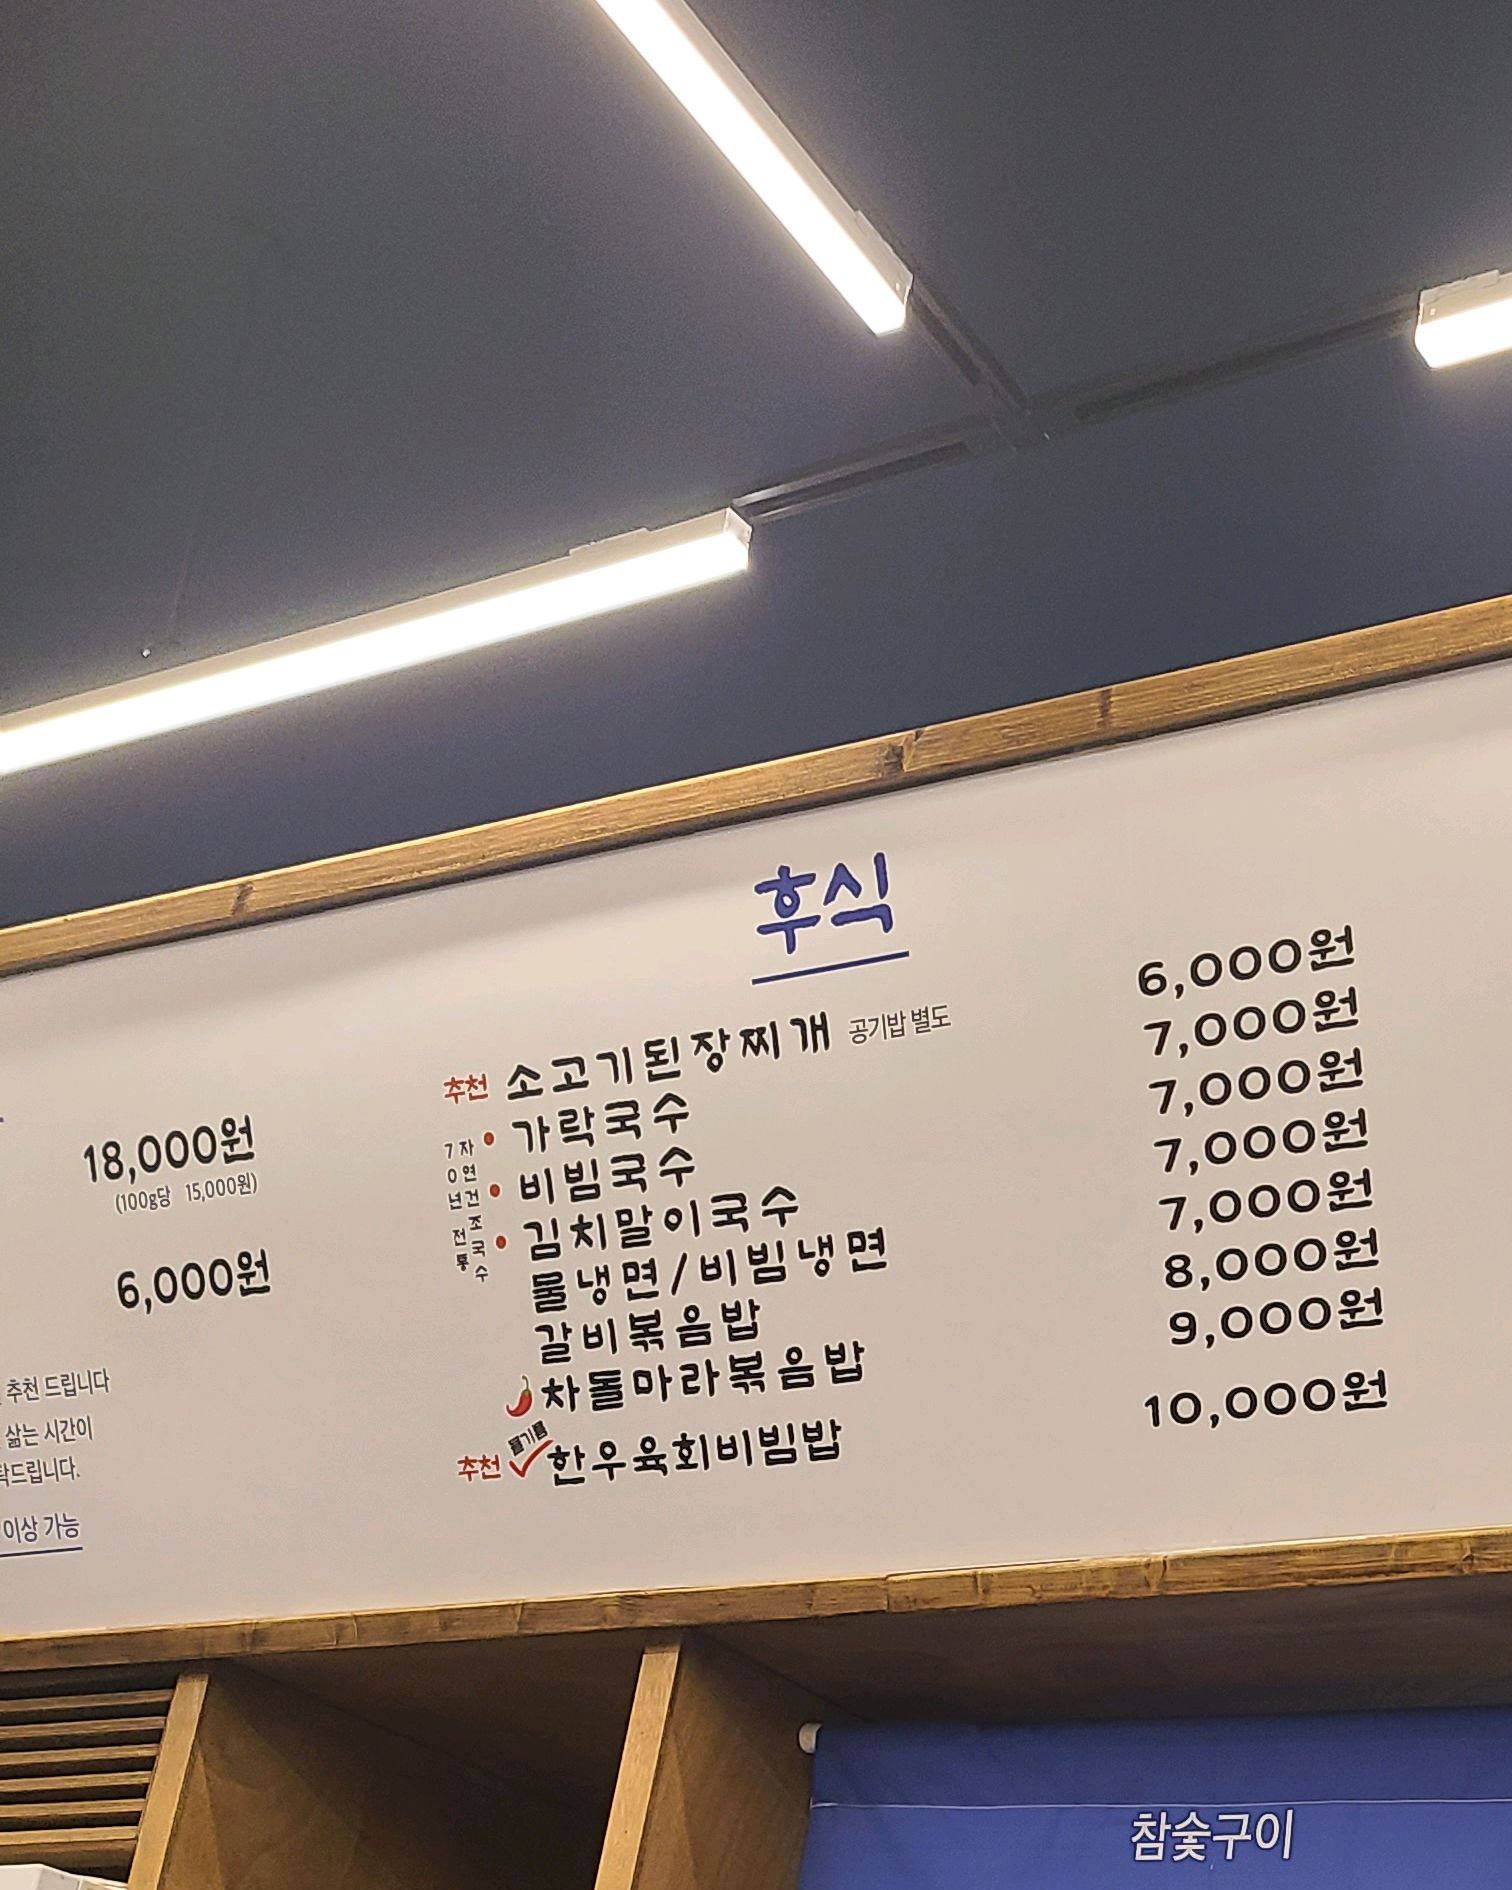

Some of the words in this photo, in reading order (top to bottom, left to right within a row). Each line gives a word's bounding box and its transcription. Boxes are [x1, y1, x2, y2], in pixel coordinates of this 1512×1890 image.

[753, 851, 894, 954] 후식
[1137, 924, 1355, 999] 6,000원
[444, 1073, 489, 1104] 추천
[507, 1011, 831, 1101] 소고기된장찌개
[848, 1011, 906, 1045] 공기밥
[910, 1004, 951, 1038] 별도
[1143, 986, 1359, 1058] 7,000원
[1148, 1047, 1363, 1117] 7,000원
[83, 1114, 256, 1185] 18,000원
[511, 1092, 690, 1155] 가락국수
[1153, 1107, 1368, 1175] 7,000원
[115, 1186, 171, 1214] (100g당
[186, 1173, 258, 1203] 15,000원)
[519, 1146, 695, 1205] 비빔국수
[1158, 1168, 1373, 1234] 7,000원
[523, 1186, 799, 1261] 김치말이국수
[116, 1249, 271, 1314] 6,000원
[532, 1226, 887, 1313] 물냉면/비빔냉면
[1164, 1227, 1379, 1292] 8,000원
[534, 1299, 761, 1365] 갈비볶음밥
[1168, 1287, 1383, 1349] 9,000원
[6, 1376, 39, 1403] 추천
[45, 1368, 110, 1398] 드립니다
[540, 1340, 865, 1413] 차돌마라볶음밥
[1144, 1369, 1388, 1429] 10,000원
[5, 1421, 39, 1449] 삶는
[44, 1415, 93, 1444] 시간이
[457, 1454, 501, 1481] 추천
[547, 1420, 842, 1487] 한우육회비빔밥
[3, 1515, 38, 1543] 이상
[44, 1512, 79, 1540] 가능
[1131, 1809, 1294, 1862] 참숯구이
